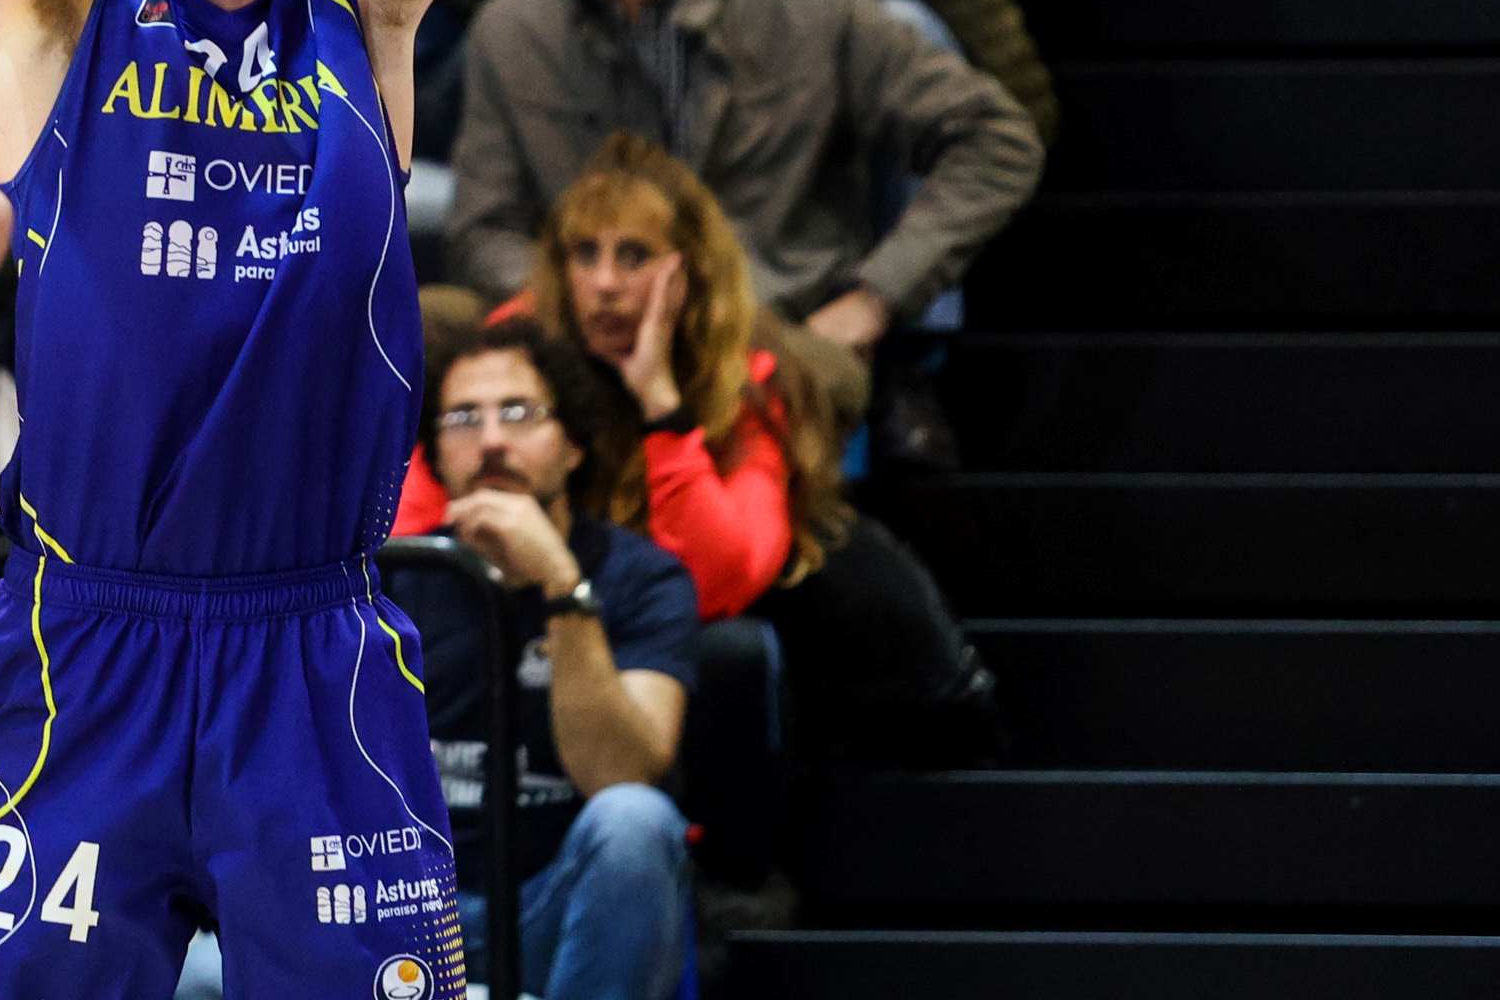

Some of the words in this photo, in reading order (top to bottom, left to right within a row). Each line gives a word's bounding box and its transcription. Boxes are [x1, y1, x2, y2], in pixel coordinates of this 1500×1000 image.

[204, 159, 313, 195] OVIED
[234, 265, 276, 283] para
[286, 235, 321, 256] ural
